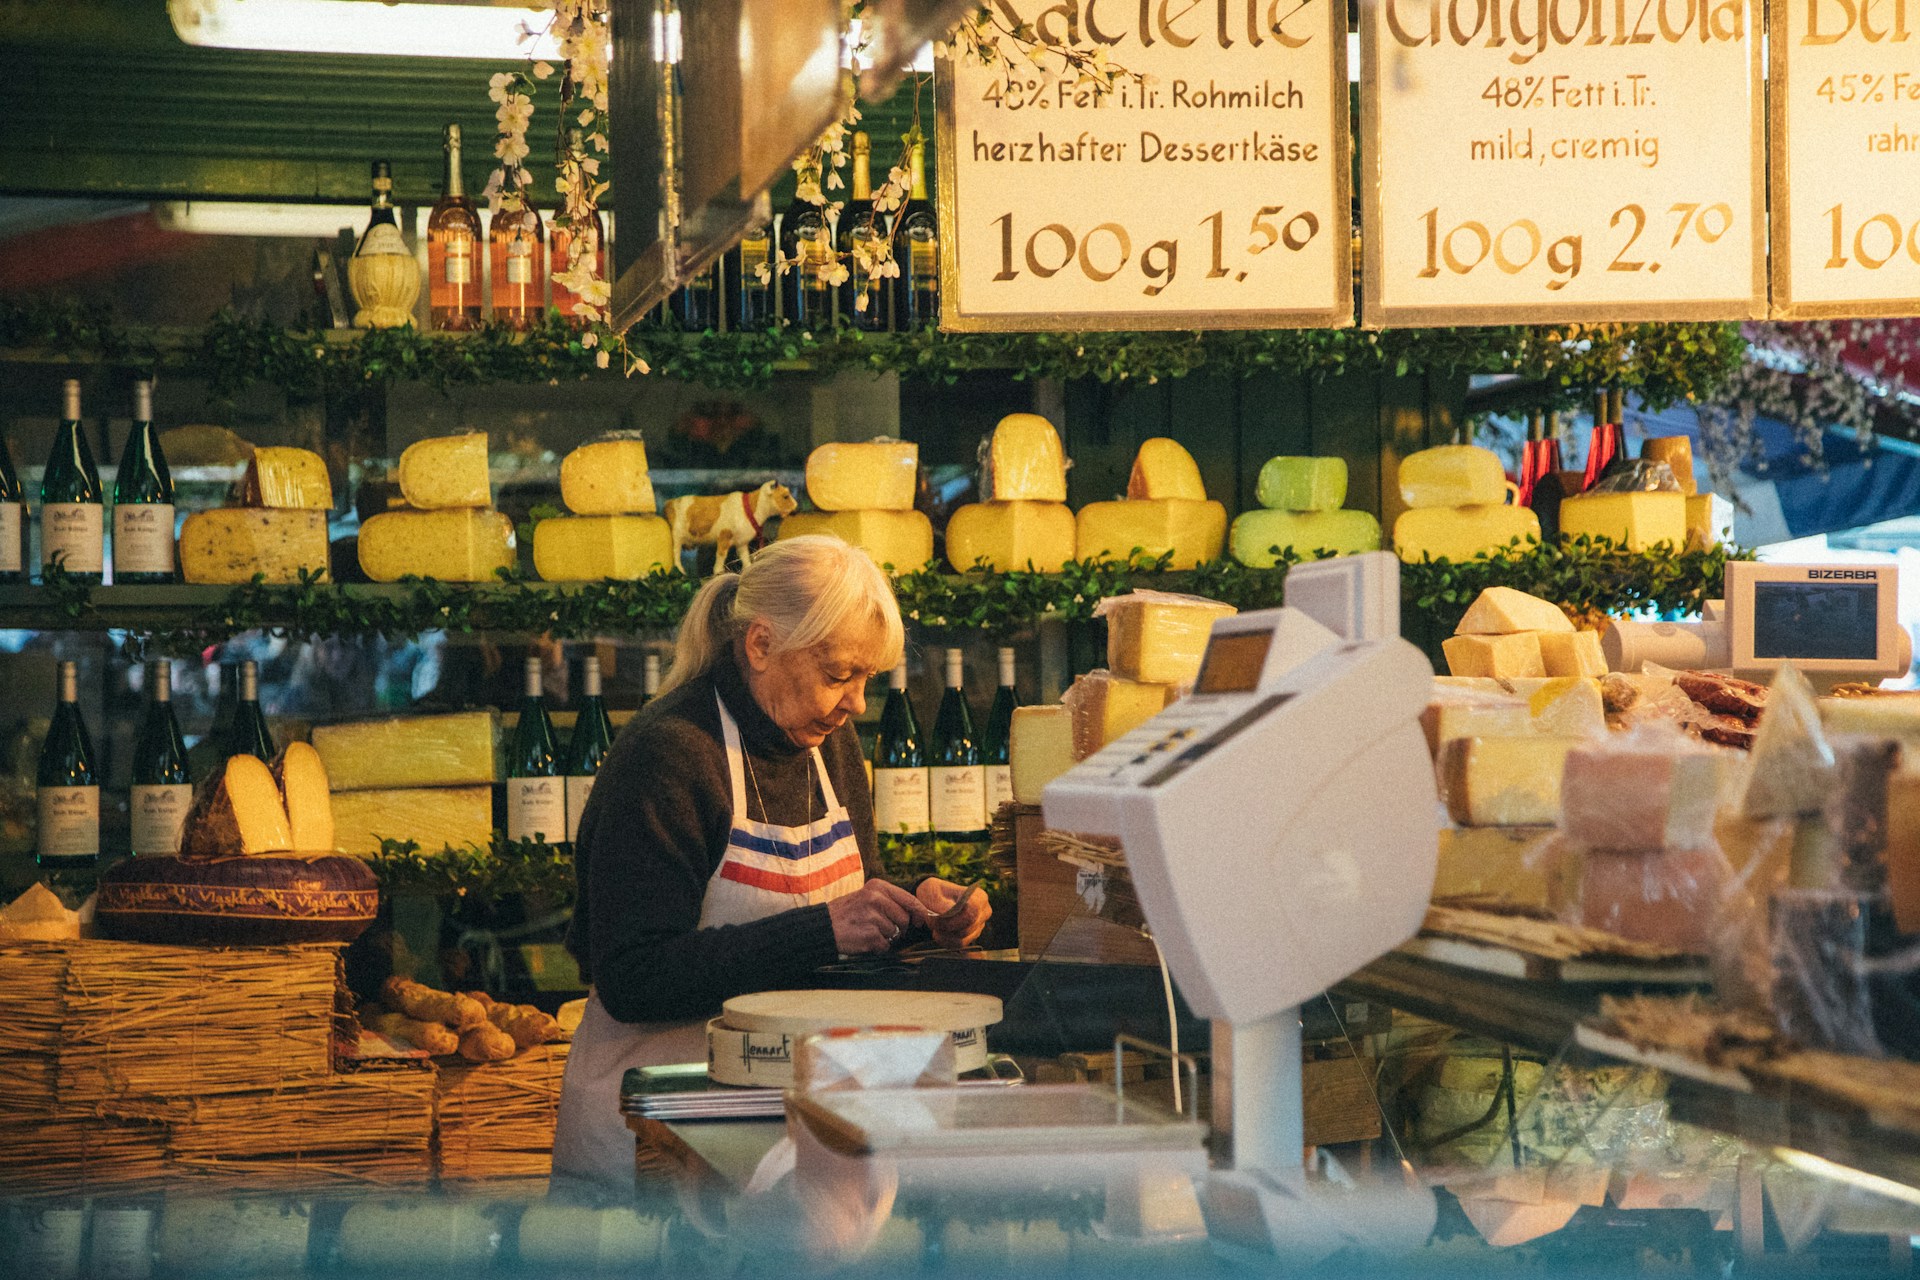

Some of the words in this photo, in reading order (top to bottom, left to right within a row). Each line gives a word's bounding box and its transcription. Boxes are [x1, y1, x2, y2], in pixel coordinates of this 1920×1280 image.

[1172, 79, 1304, 109] Rohmilch
[1481, 75, 1545, 109] 48%
[1551, 75, 1606, 108] Fett
[1815, 73, 1885, 104] 45%
[972, 130, 1127, 163] herzhafter
[1140, 131, 1319, 163] Dessertkäse
[1551, 130, 1659, 168] cremig
[1822, 203, 1920, 270] 10
[1808, 570, 1877, 580] BIZERBA
